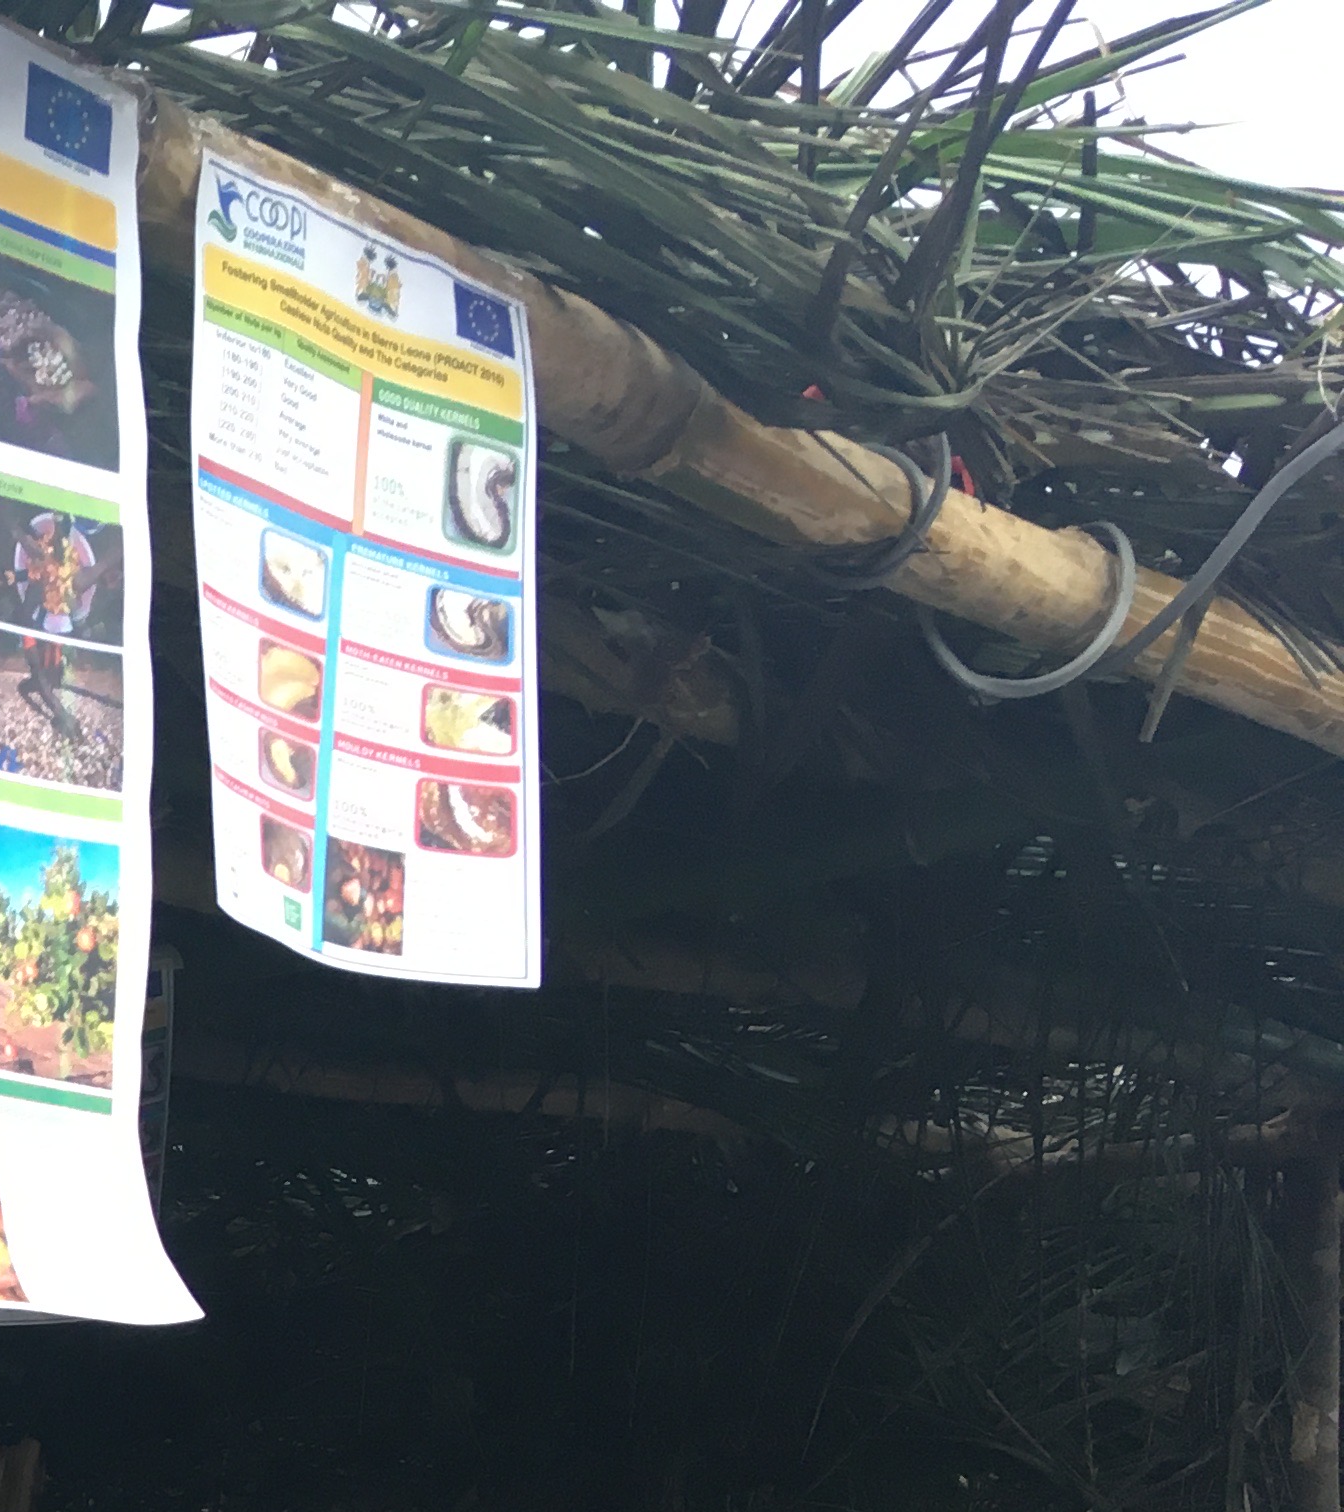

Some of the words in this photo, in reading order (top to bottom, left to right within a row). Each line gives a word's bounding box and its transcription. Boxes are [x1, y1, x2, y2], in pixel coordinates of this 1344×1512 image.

[245, 190, 307, 241] COOPI
[222, 260, 268, 291] Fostering
[371, 330, 399, 353] Sierra
[400, 342, 432, 363] Leone
[433, 351, 479, 375] (PROACT
[280, 299, 312, 325] Cashew
[359, 343, 374, 359] and
[376, 349, 393, 367] The
[394, 356, 449, 383] Categories
[378, 388, 403, 407] GOOD
[403, 396, 440, 418] QUALITY
